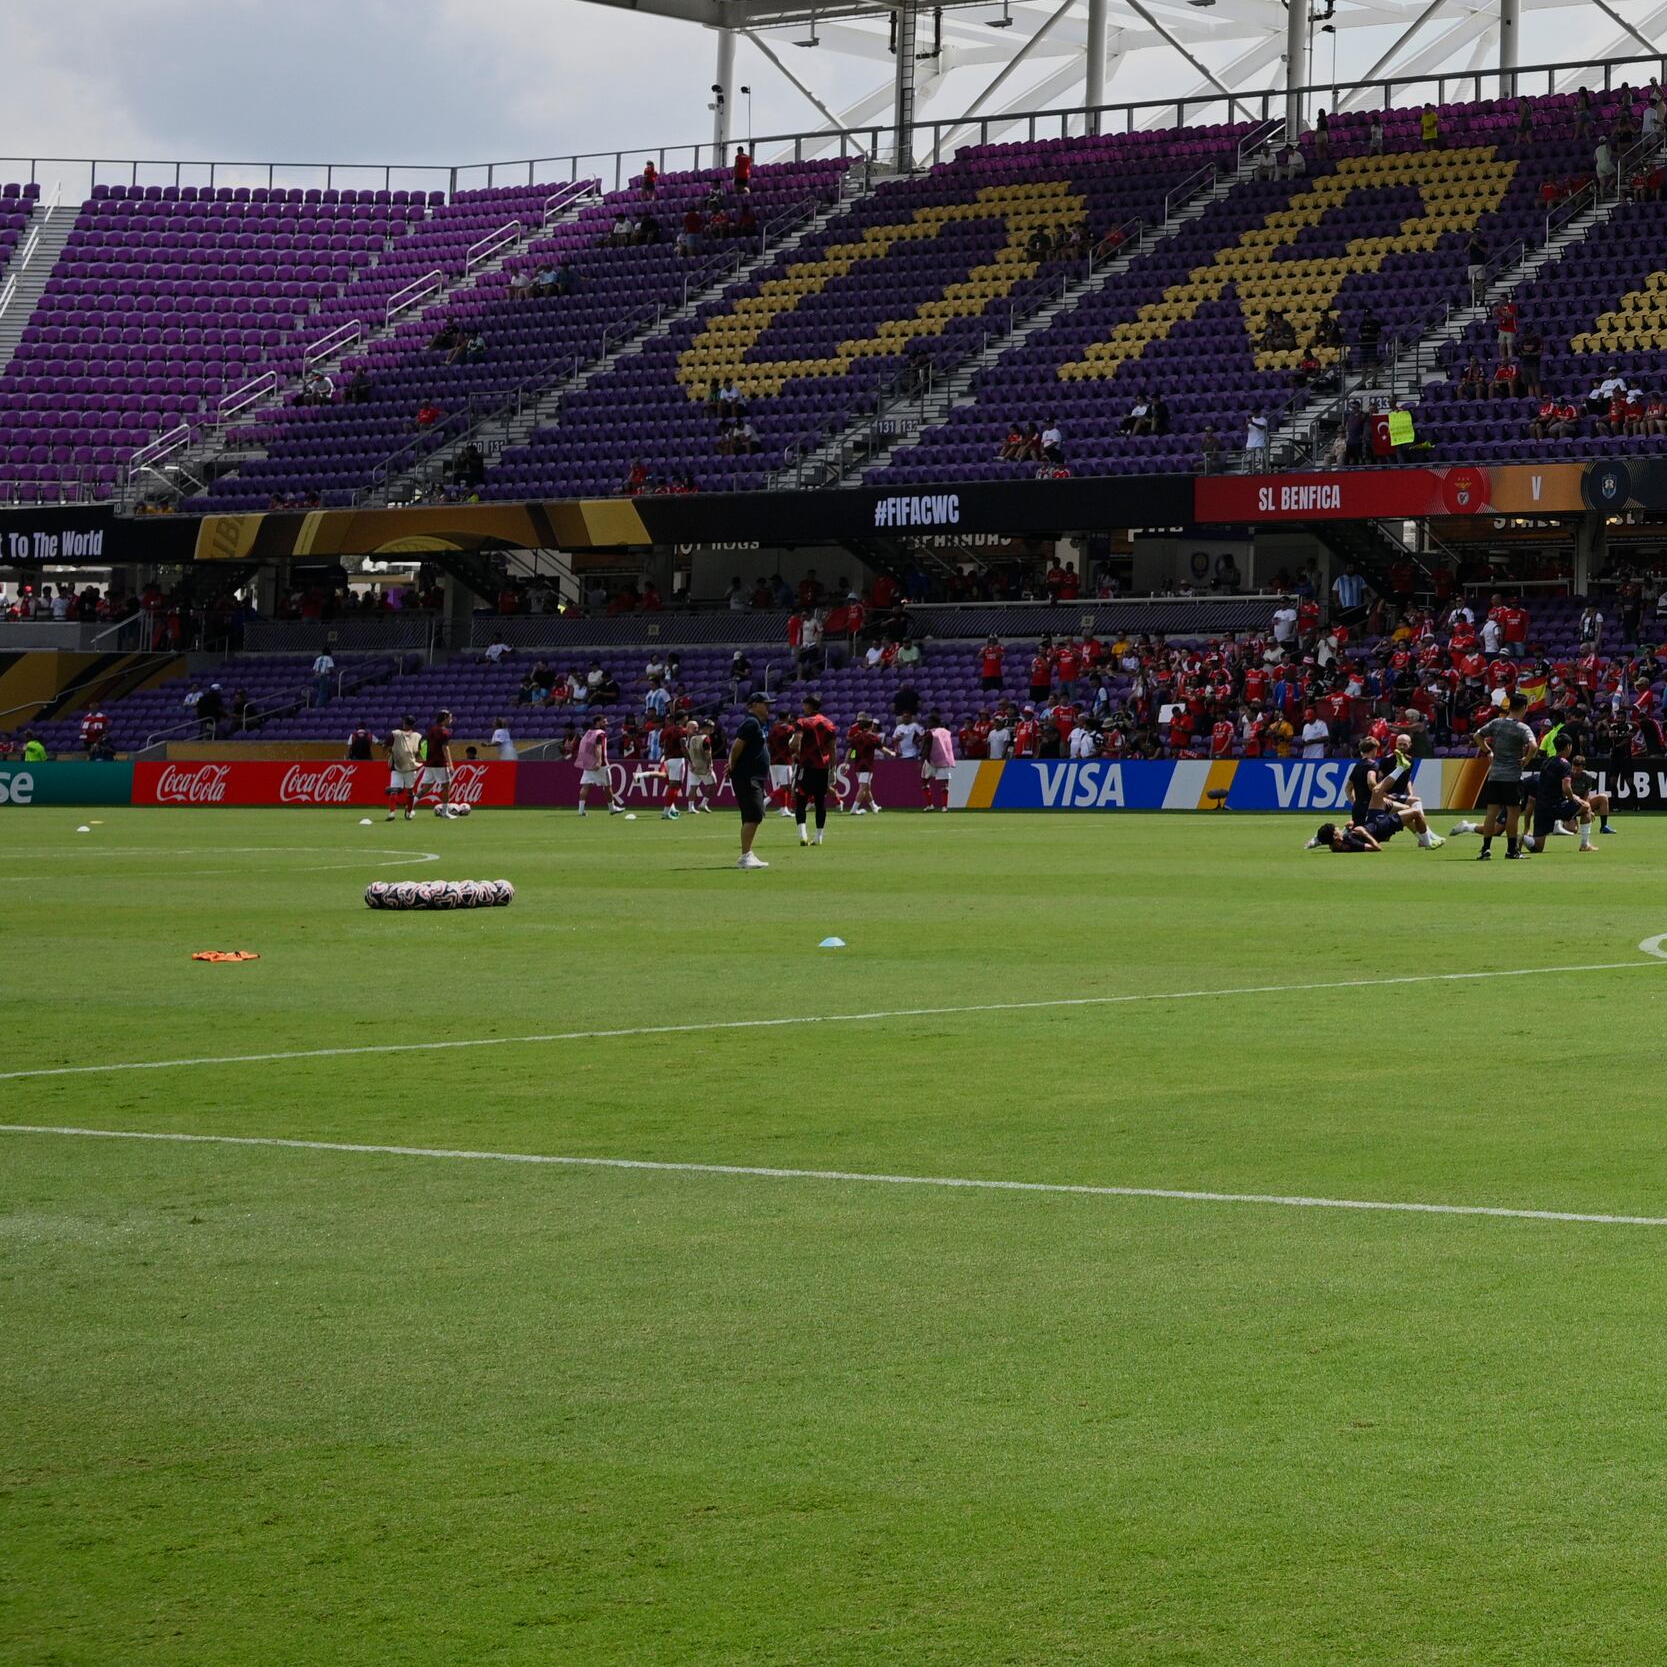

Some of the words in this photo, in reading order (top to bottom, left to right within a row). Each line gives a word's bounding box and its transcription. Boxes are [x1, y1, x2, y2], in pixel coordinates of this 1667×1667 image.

[880, 420, 896, 434] 131
[1258, 487, 1276, 512] SL
[1281, 484, 1341, 510] BENFICA
[1532, 476, 1541, 501] V
[874, 493, 960, 527] #FIFACWC
[9, 532, 28, 558] To
[33, 532, 59, 557] The
[62, 529, 104, 557] World
[156, 763, 231, 802] Coca-Cola
[279, 763, 359, 803] Coca-Cola
[1031, 762, 1125, 806] VISA
